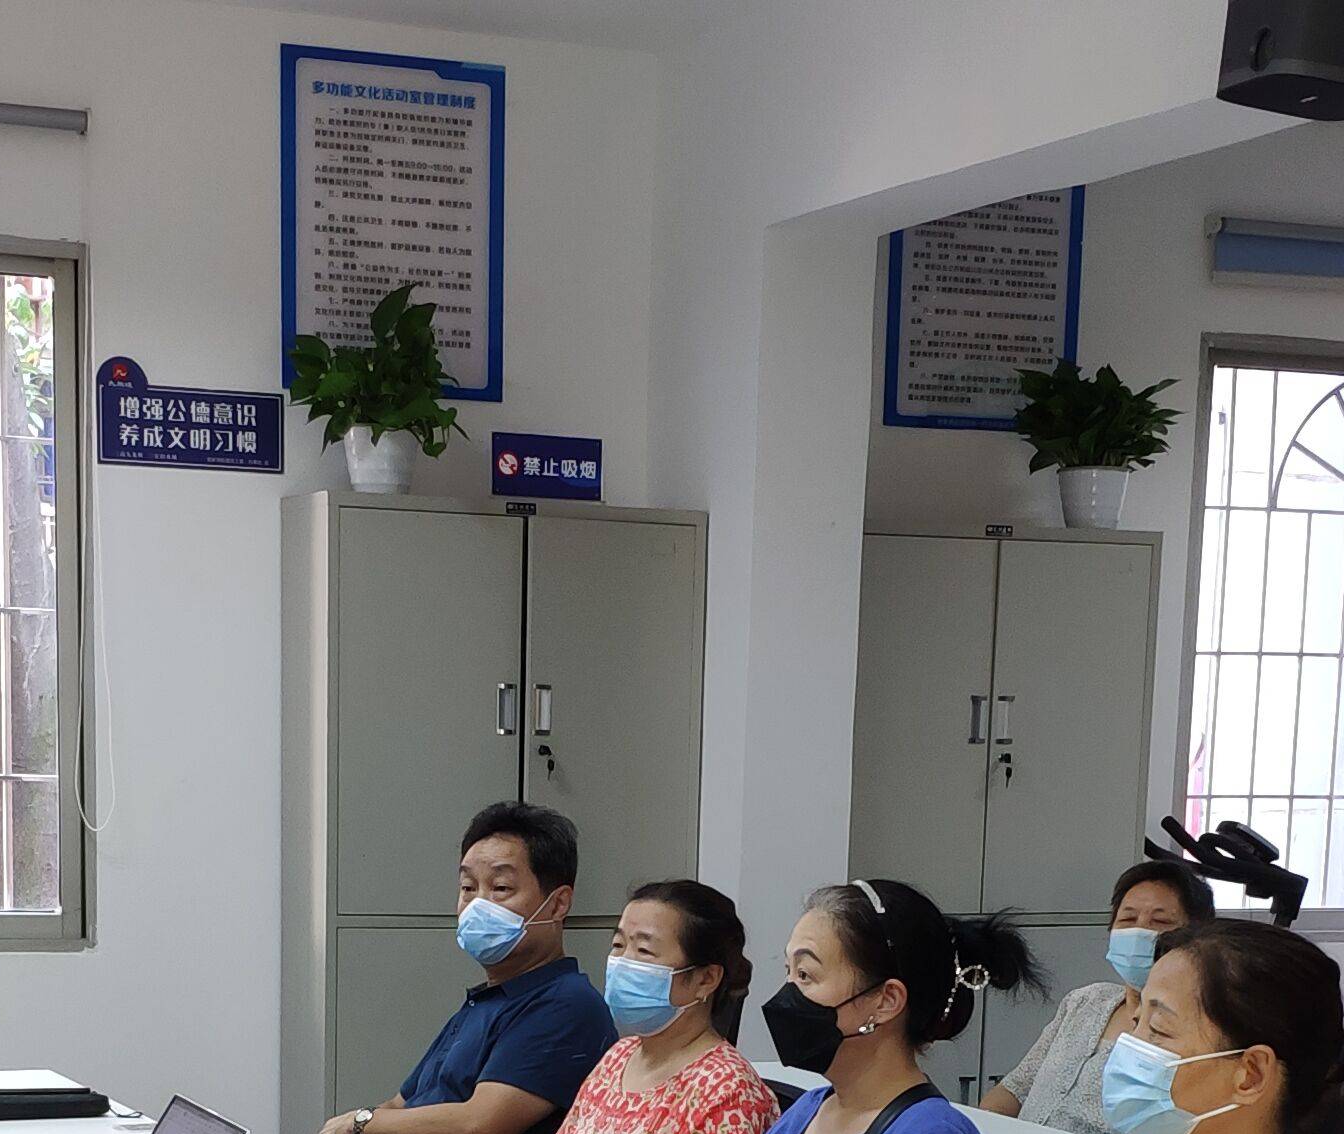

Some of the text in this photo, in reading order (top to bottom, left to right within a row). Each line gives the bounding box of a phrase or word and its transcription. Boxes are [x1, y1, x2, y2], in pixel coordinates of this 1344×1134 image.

[311, 80, 477, 110] 多功能文化活动室管理制度
[119, 396, 258, 428] 增强公德意识
[119, 423, 258, 455] 养成文明习惯
[522, 455, 597, 481] 禁止吸烟
